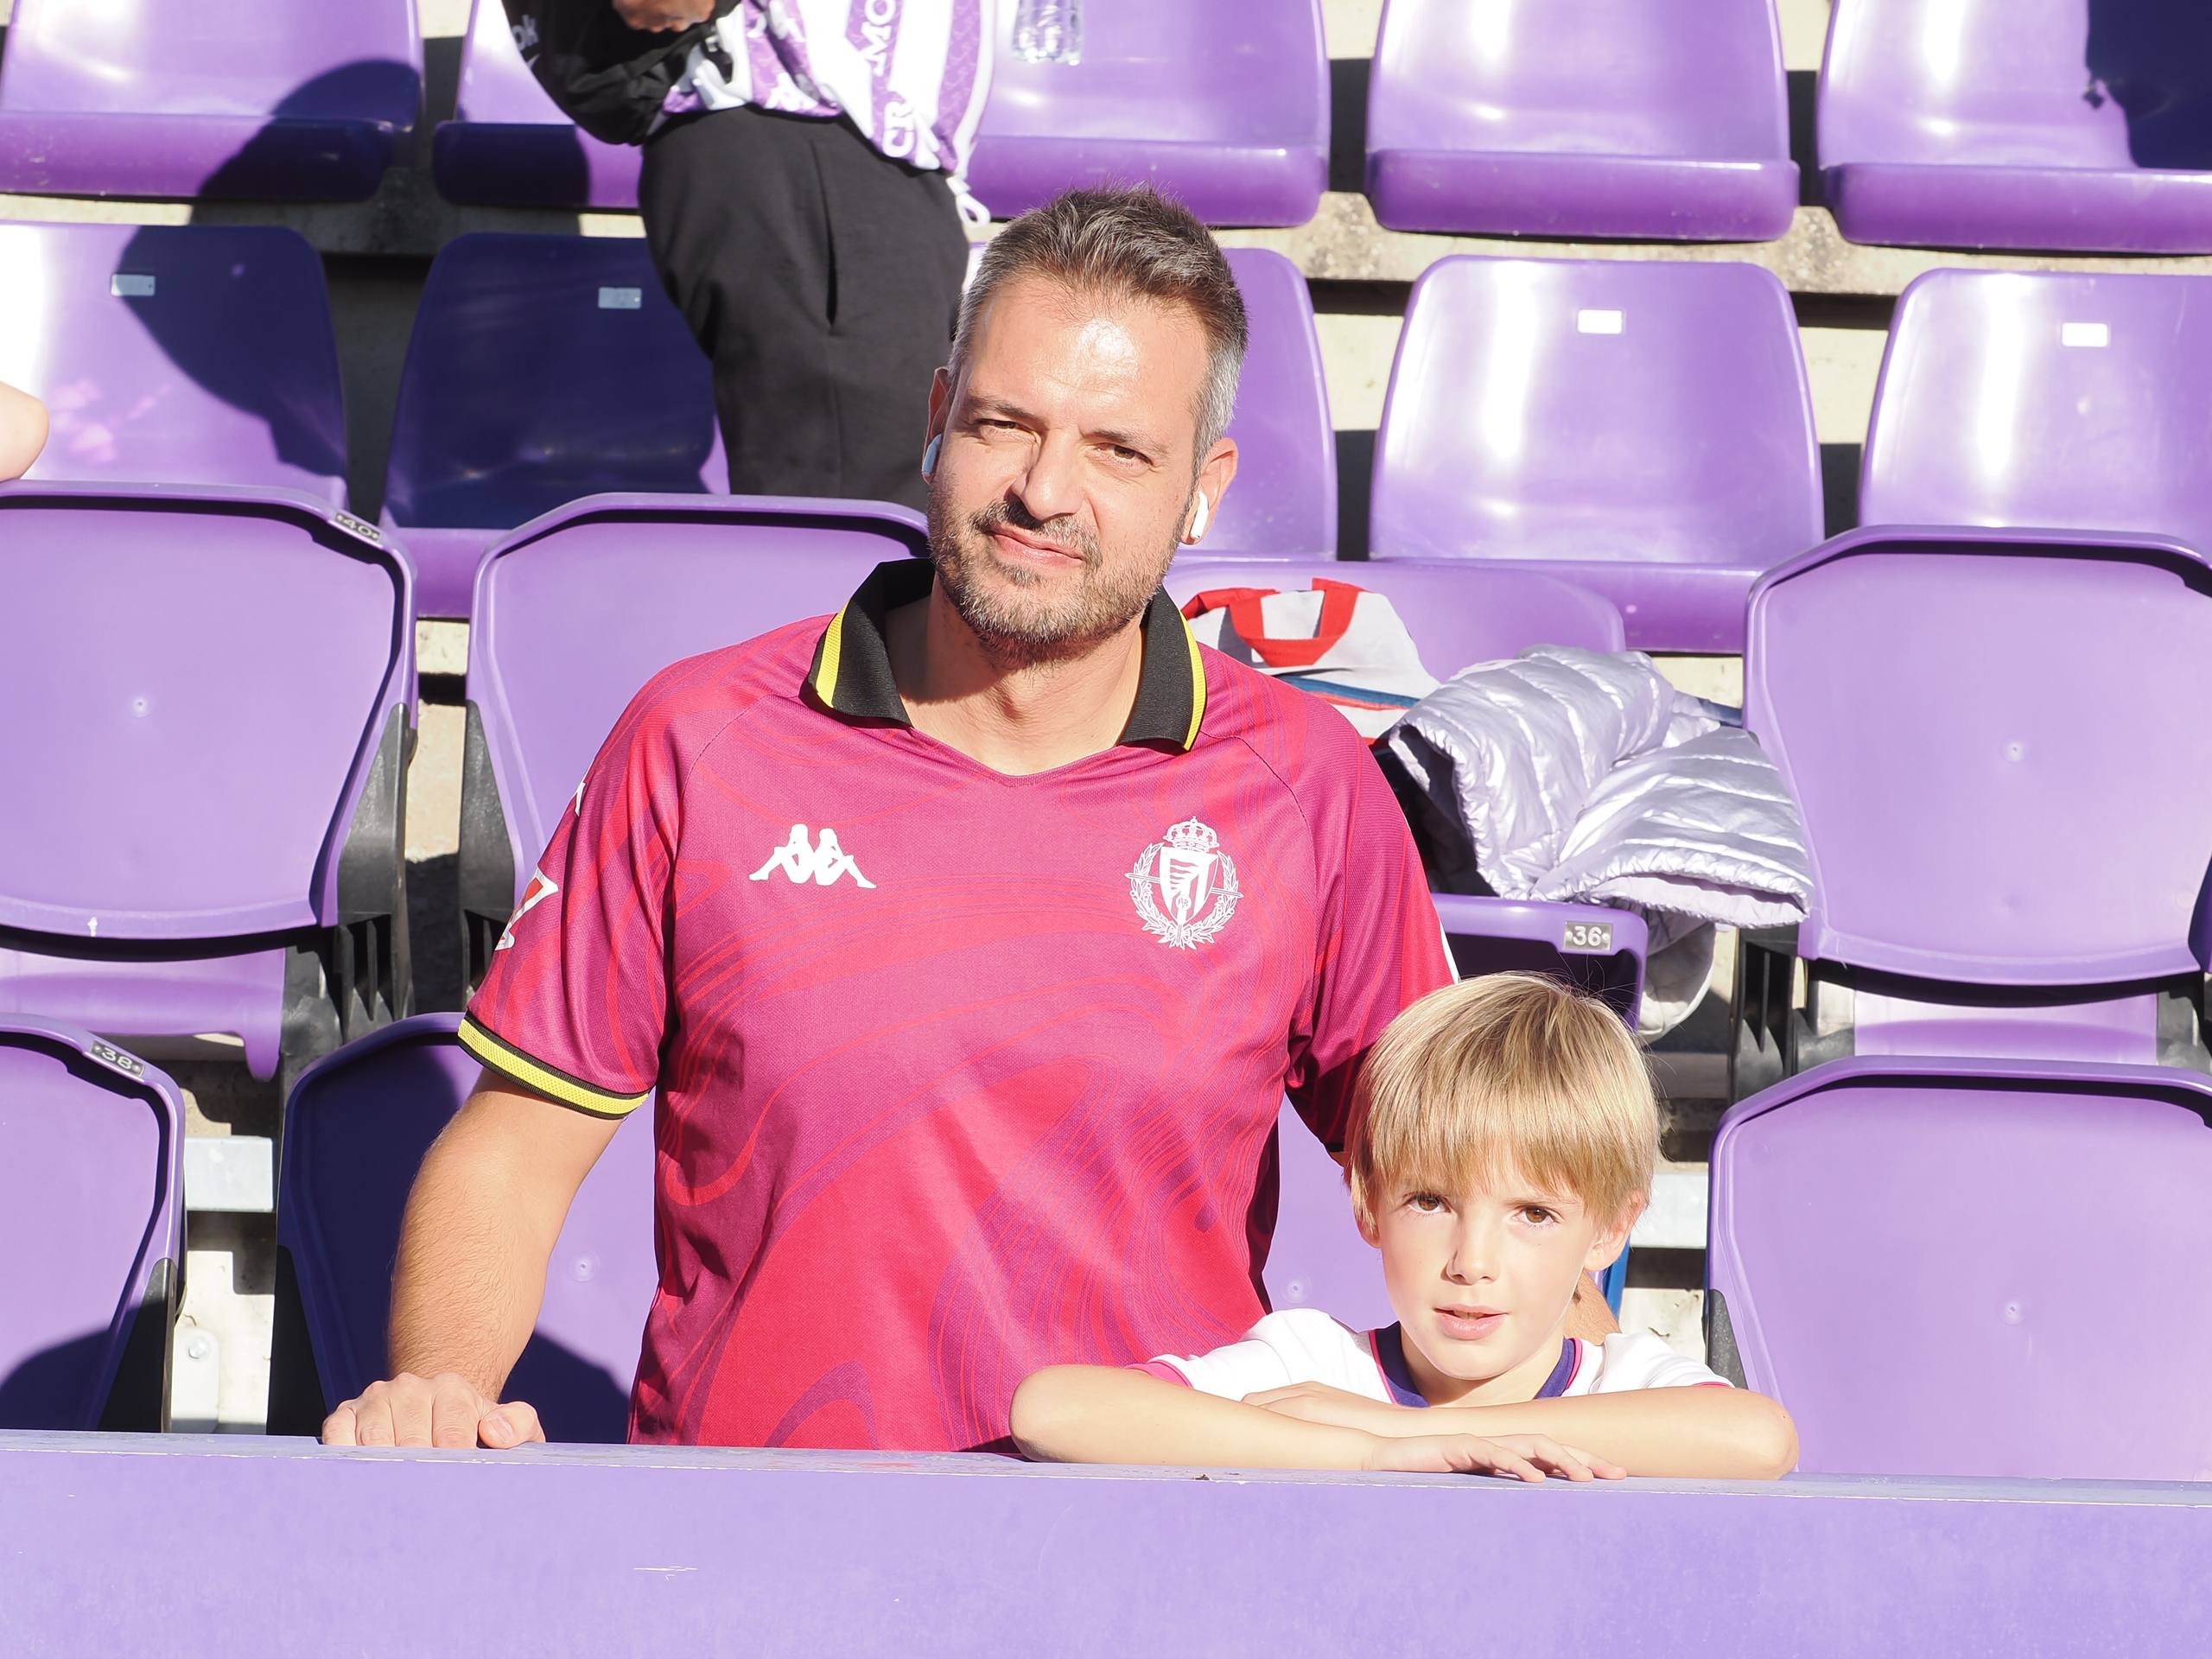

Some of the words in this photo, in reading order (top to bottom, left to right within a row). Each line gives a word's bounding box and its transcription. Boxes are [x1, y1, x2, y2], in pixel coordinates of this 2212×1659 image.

[343, 518, 372, 537] 40
[1573, 925, 1602, 946] 36
[102, 1046, 133, 1070] 38
